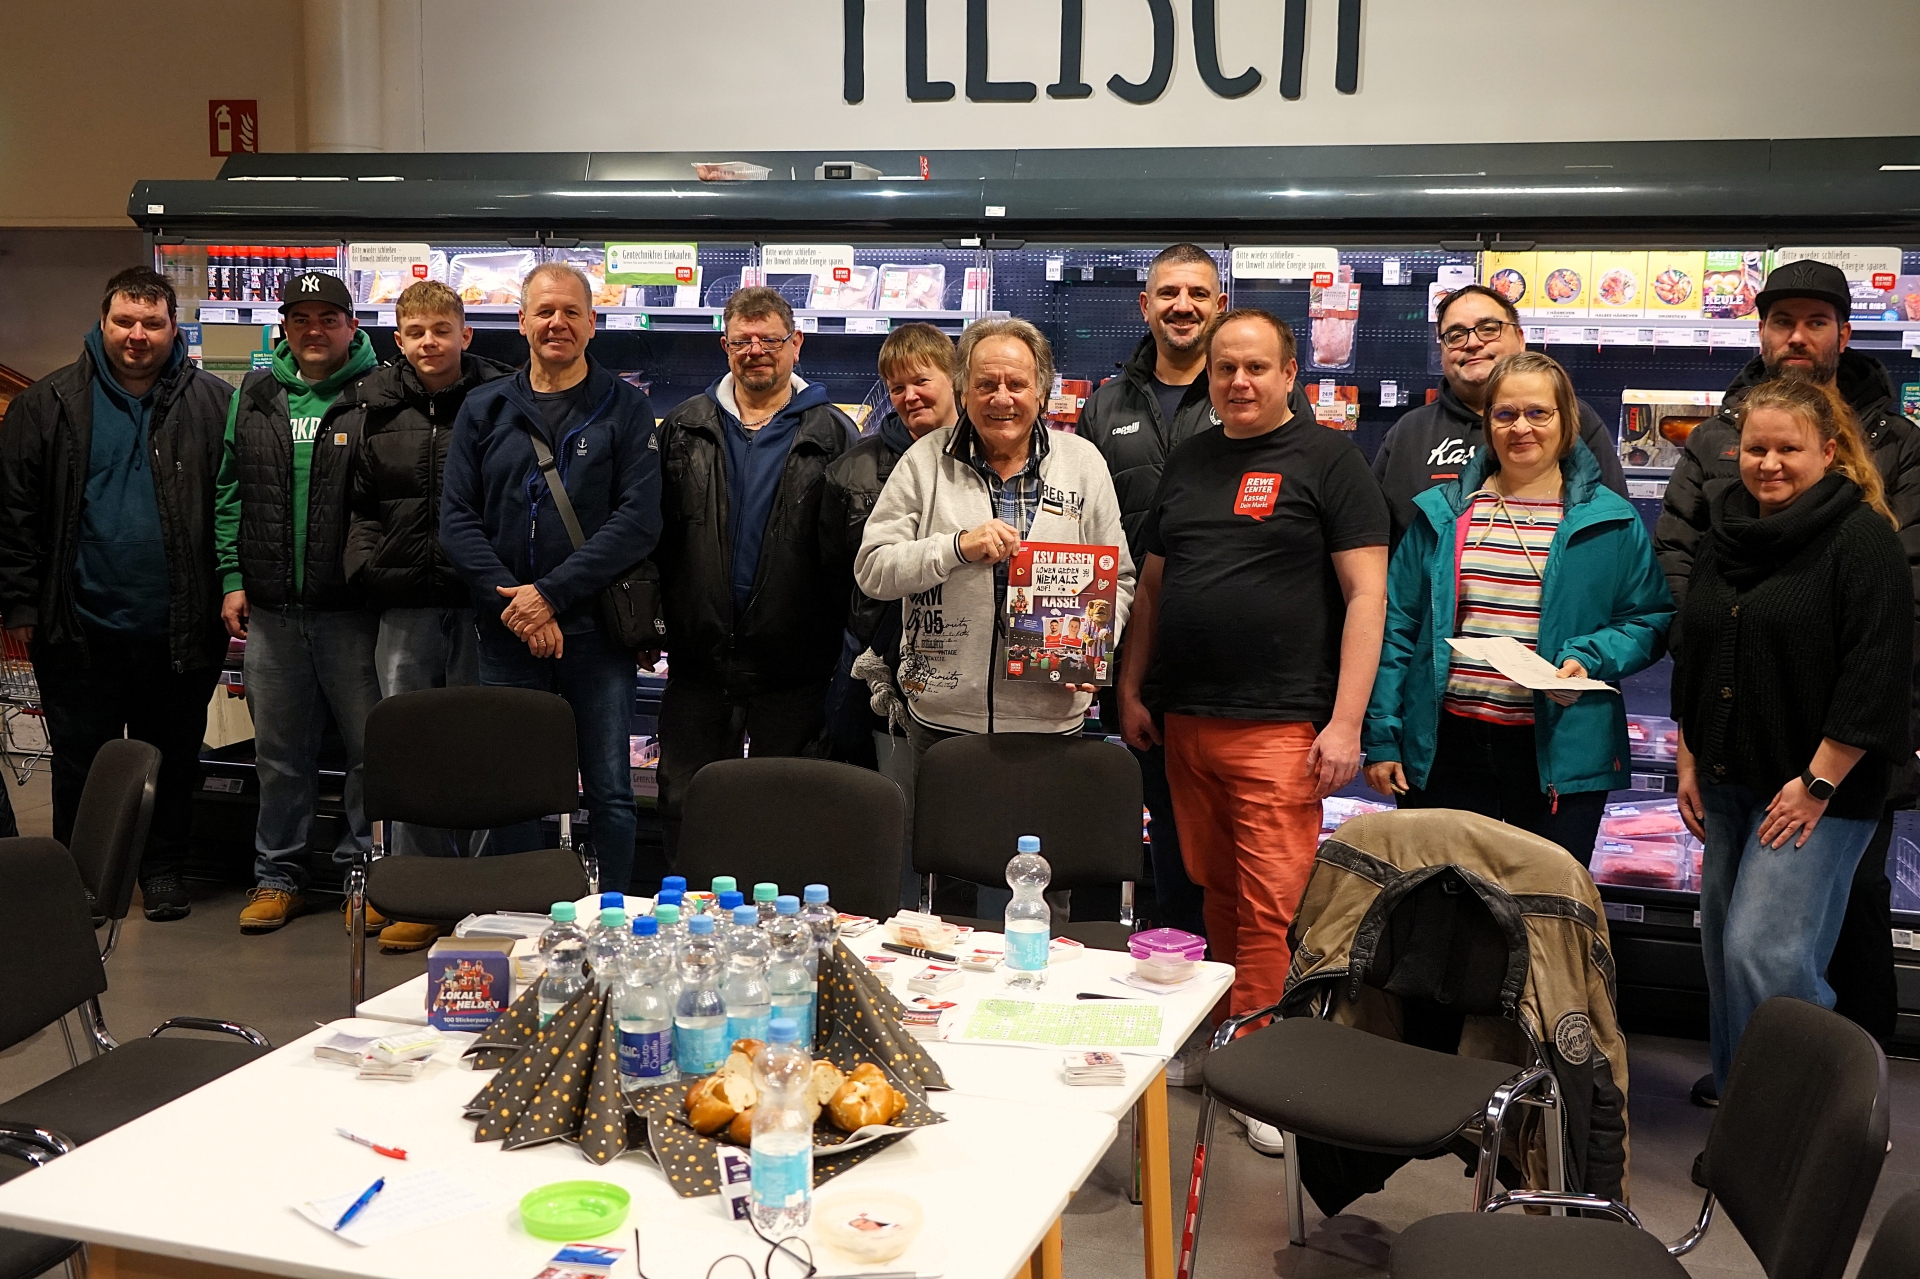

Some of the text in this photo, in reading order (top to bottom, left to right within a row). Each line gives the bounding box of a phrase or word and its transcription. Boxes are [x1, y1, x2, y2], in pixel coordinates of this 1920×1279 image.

[392, 255, 406, 264] Energie
[622, 250, 693, 260] Gentechnikfrei Einkaufen.
[1236, 251, 1294, 259] Bitte wieder schließen
[1782, 251, 1850, 260] Bitte wieder schließen
[810, 258, 826, 266] Energie
[1287, 261, 1306, 271] Energie
[1308, 262, 1326, 271] sparen.
[1841, 262, 1888, 272] Energie sparen.
[1705, 295, 1744, 304] KEULE
[1033, 551, 1094, 565] KSV HESSEN
[1042, 596, 1080, 609] KASSEL
[640, 1041, 650, 1069] Teuto-
[650, 1040, 659, 1069] Quelle
